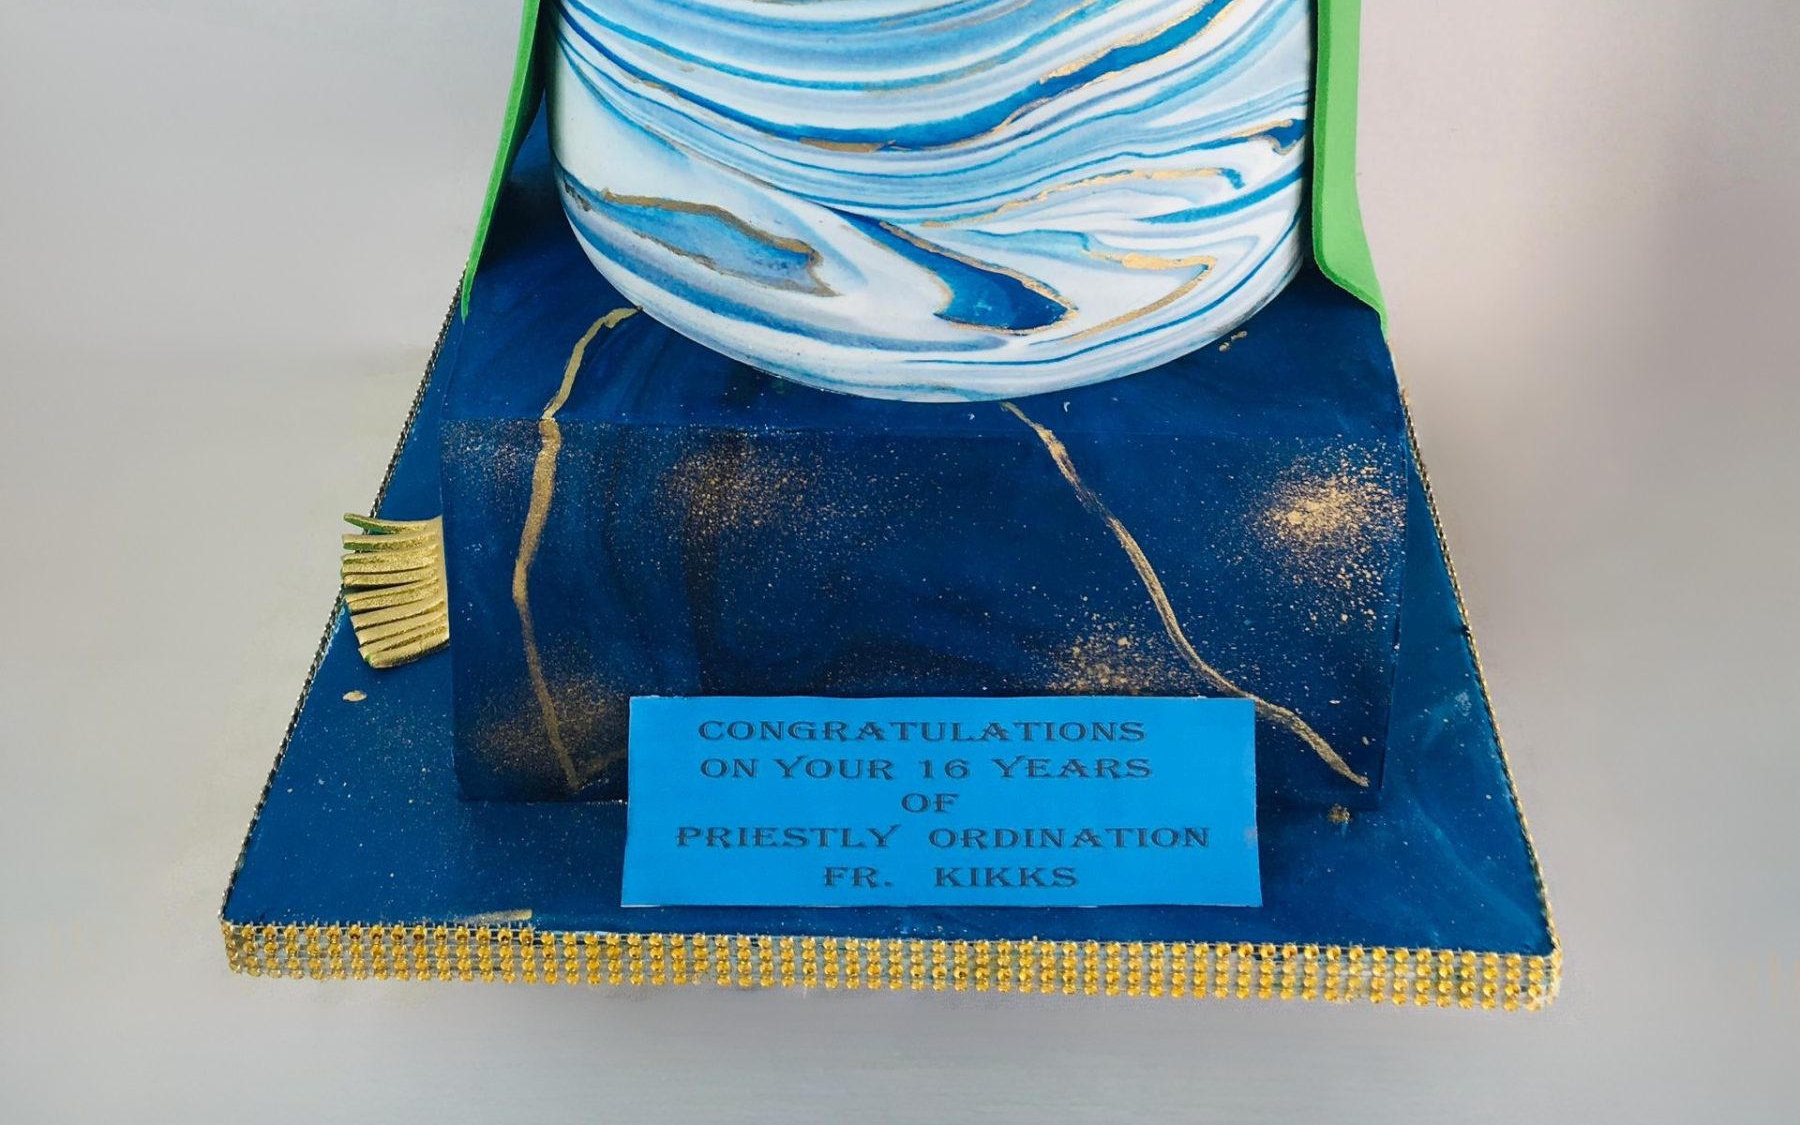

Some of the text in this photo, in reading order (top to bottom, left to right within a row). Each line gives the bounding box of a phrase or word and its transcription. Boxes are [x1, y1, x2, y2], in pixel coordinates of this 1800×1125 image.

[697, 720, 1146, 743] CONGRATULATIONS
[699, 754, 1153, 781] ON YOUR 16 YEARS
[900, 792, 960, 814] OF
[675, 824, 1210, 851] PRIESTLY ORDINATION
[822, 866, 1080, 890] FR. KIKKS
